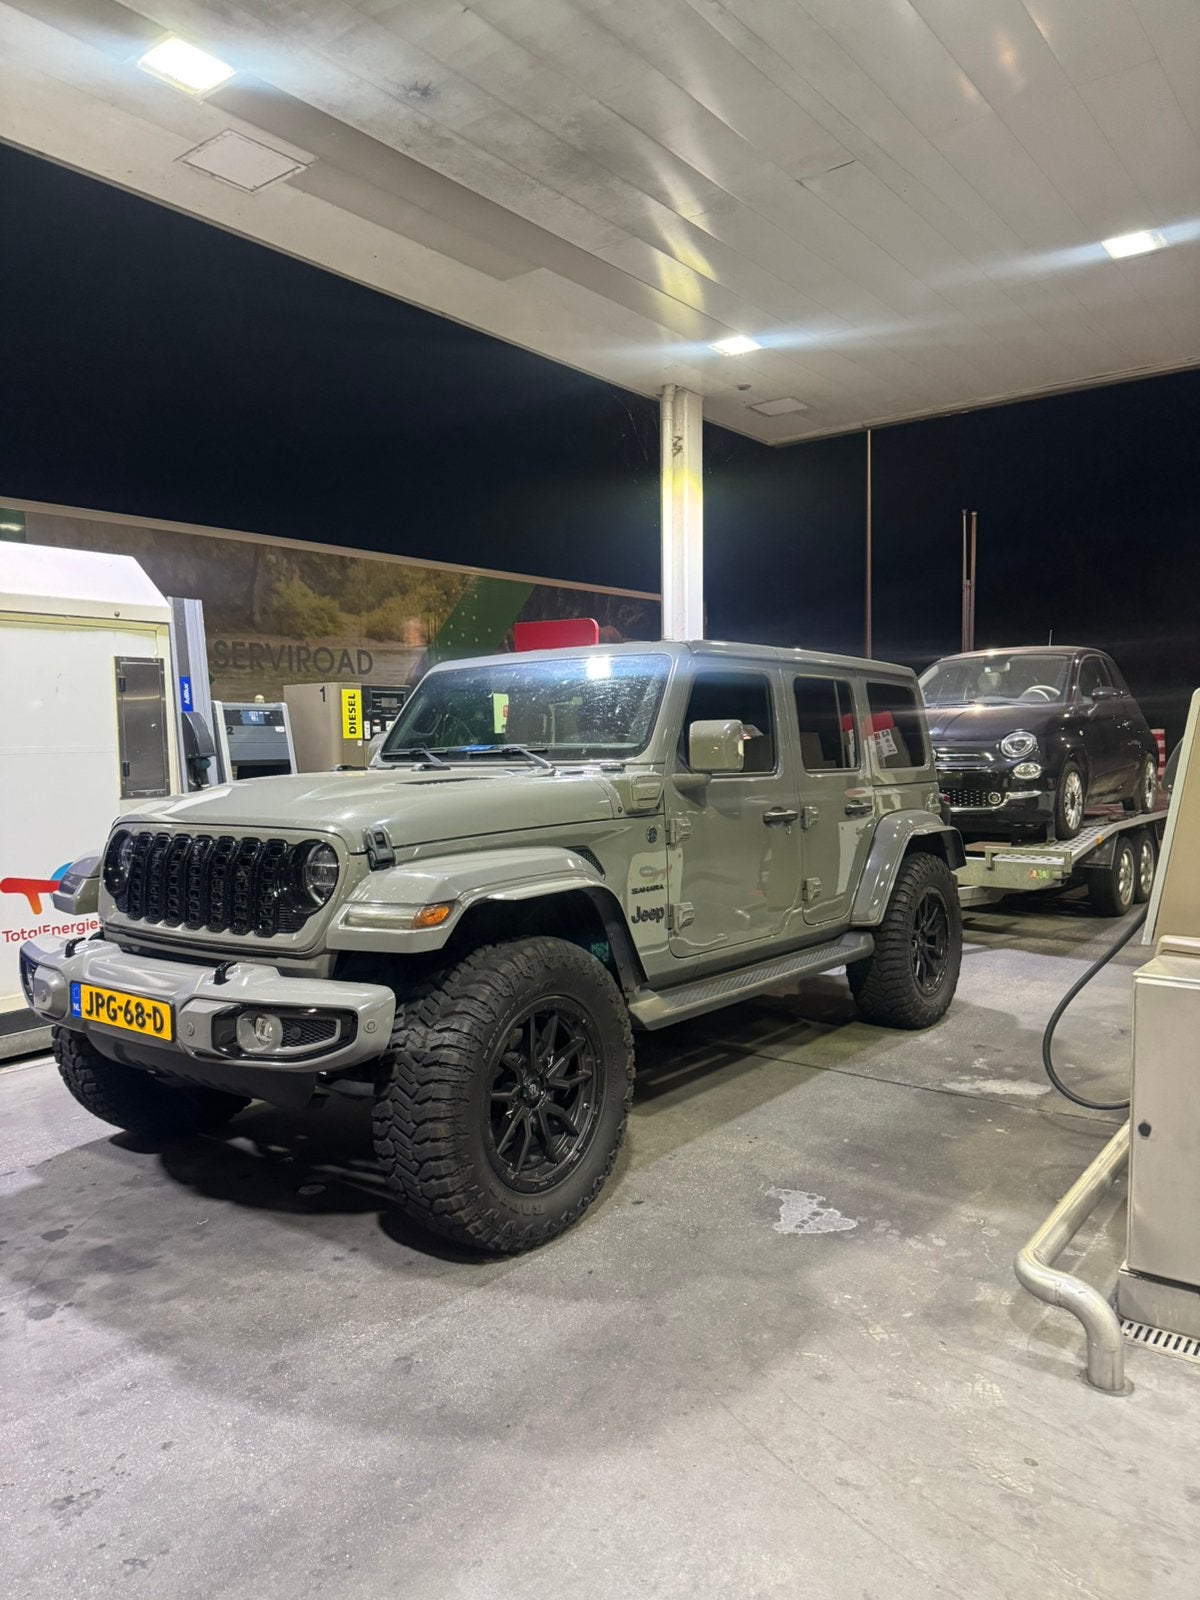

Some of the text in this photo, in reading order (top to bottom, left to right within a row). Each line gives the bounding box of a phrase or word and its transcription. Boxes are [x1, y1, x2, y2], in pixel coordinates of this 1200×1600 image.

[214, 640, 374, 675] SERVIROAD
[319, 686, 326, 703] 1
[347, 693, 357, 735] DIESEL
[226, 726, 234, 736] 2
[631, 906, 665, 924] Jeep
[85, 991, 164, 1034] JPG-68-D
